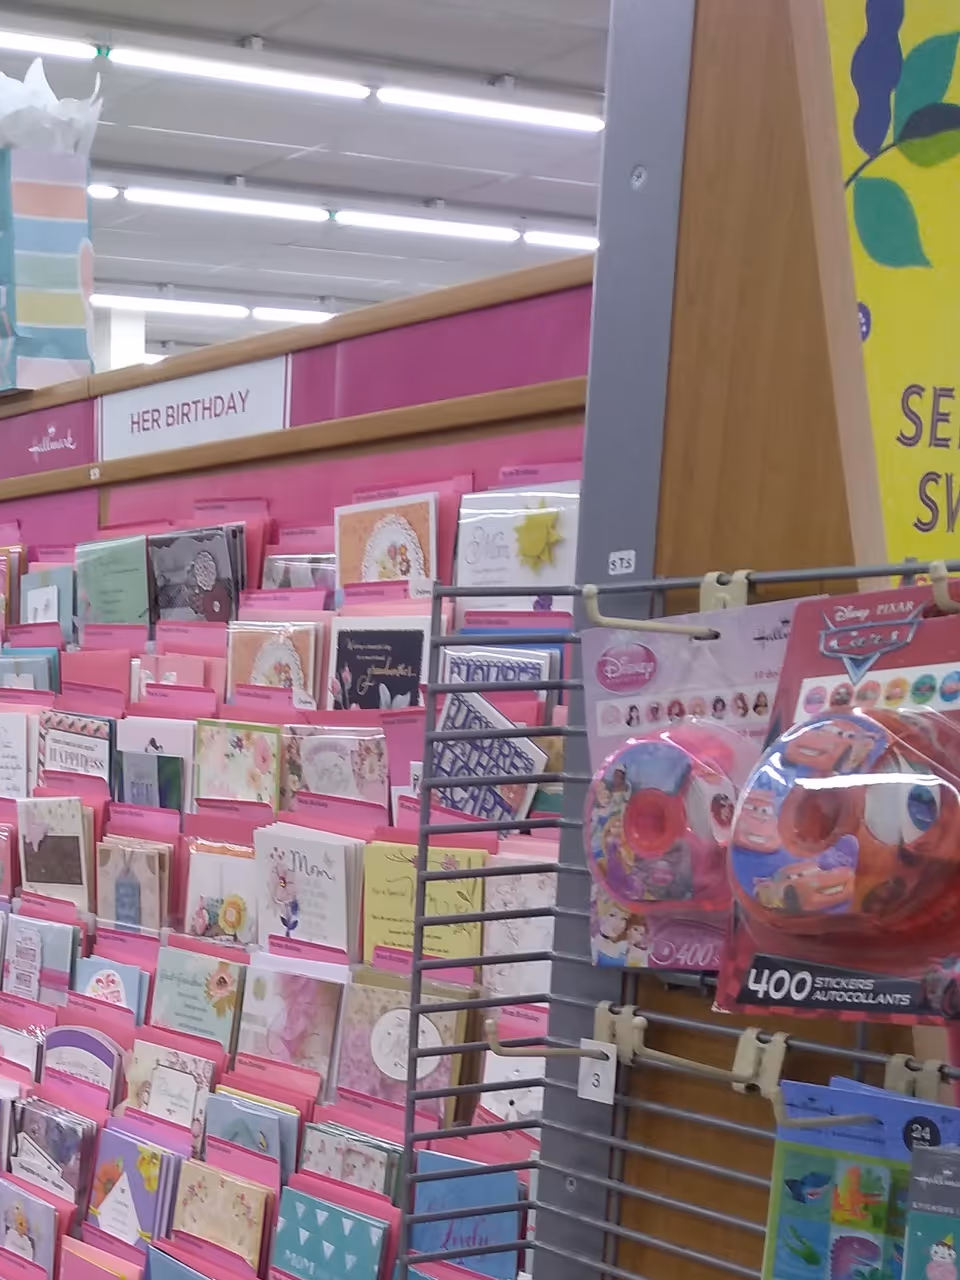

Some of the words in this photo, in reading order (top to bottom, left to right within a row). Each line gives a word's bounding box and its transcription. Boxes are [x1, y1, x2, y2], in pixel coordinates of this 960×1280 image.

[130, 408, 161, 434] HER
[165, 389, 250, 427] BIRTHDAY
[896, 384, 960, 449] SE
[28, 429, 77, 463] Hallmark
[876, 601, 915, 615] PIXAR
[288, 850, 336, 880] Mom
[677, 943, 714, 966] 400
[747, 968, 813, 1001] 400
[814, 977, 875, 990] STICKERS
[813, 990, 911, 1006] AUTOCOLLANTS
[591, 1073, 600, 1088] 3
[911, 1123, 931, 1140] 24
